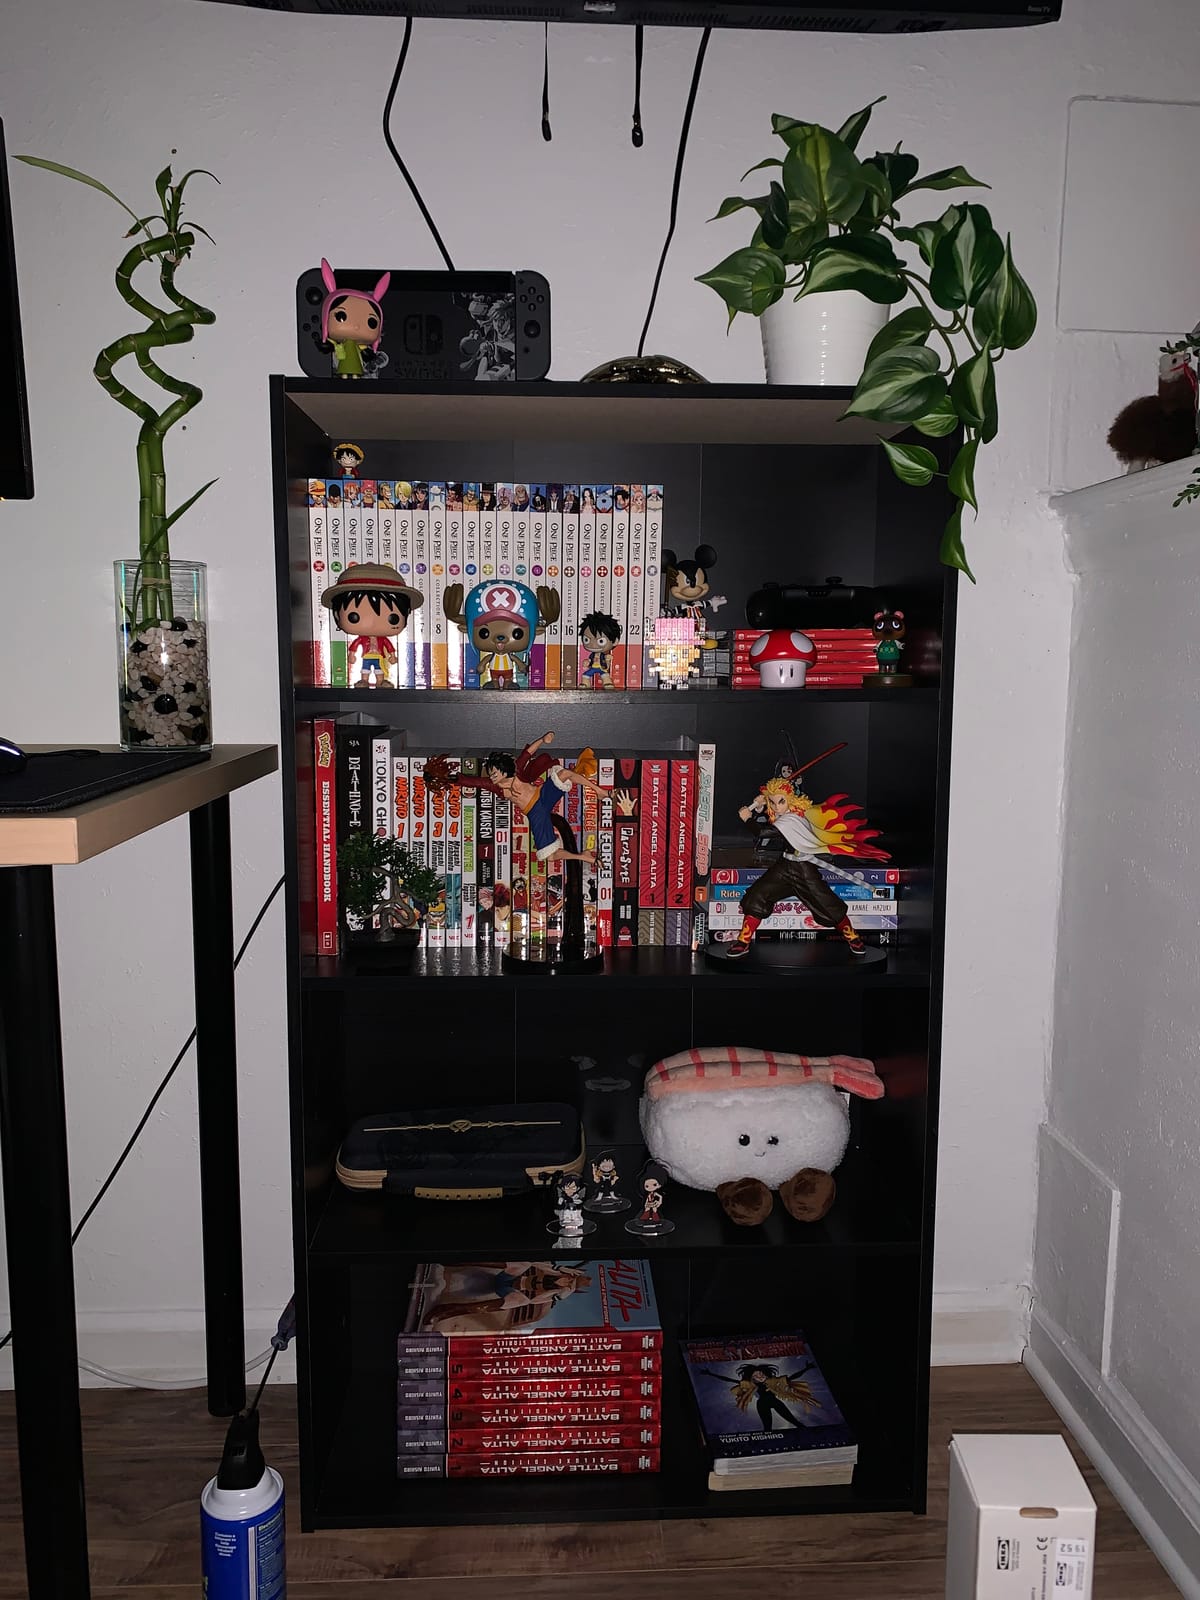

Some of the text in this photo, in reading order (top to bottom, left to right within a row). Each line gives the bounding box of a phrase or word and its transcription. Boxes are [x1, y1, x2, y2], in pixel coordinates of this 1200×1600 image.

[313, 518, 323, 556] ONE PIECE
[331, 518, 341, 557] ONE PIECE
[348, 518, 358, 557] ONE PIECE
[364, 518, 374, 557] ONE PIECE
[382, 520, 392, 558] ONE PIECE
[434, 520, 442, 538] ONE
[567, 524, 575, 541] ONE
[617, 522, 626, 540] ONE
[634, 522, 642, 540] ONE
[650, 522, 658, 540] ONE
[399, 520, 409, 559] ONE PIECE
[415, 520, 425, 559] ONE PIECE
[450, 522, 459, 560] ONE PIECE
[466, 520, 476, 560] ONE PIECE
[482, 520, 492, 560] ONE PIECE
[500, 522, 510, 560] ONE PIECE
[516, 522, 526, 560] ONE PIECE
[533, 522, 543, 561] ONE PIECE
[549, 522, 559, 561] ONE PIECE
[582, 524, 592, 562] ONE PIECE
[599, 522, 609, 562] ONE PIECE
[432, 540, 442, 560] PIECE
[566, 542, 574, 562] PIECE
[616, 541, 625, 561] PIECE
[633, 542, 642, 562] PIECE
[649, 541, 658, 561] PIECE
[435, 624, 442, 635] 8
[548, 624, 558, 636] 15
[564, 625, 574, 636] 16
[628, 624, 640, 636] 22
[375, 758, 387, 838] TOKYO GHO
[395, 776, 408, 818] NARUTO
[412, 776, 425, 818] NARUTO
[432, 791, 444, 819] RUTO
[448, 784, 460, 818] ARUTO
[496, 796, 508, 814] UNCH
[700, 773, 712, 821] SWEAT
[322, 781, 330, 842] ESSENTIAL
[584, 802, 597, 832] PIECE
[397, 823, 405, 839] 1
[414, 822, 423, 838] 2
[432, 822, 443, 838] 3
[448, 822, 458, 838] 4
[480, 810, 493, 839] KAISEN
[496, 831, 508, 843] 01
[586, 834, 596, 850] 6
[600, 797, 612, 879] FIRE FORCE
[678, 820, 686, 856] ANGEL
[484, 846, 490, 858] 1
[696, 832, 709, 876] SOAP
[600, 888, 611, 900] 01
[675, 894, 683, 904] 2
[720, 890, 741, 898] Ride
[572, 1343, 622, 1351] BATTLE
[451, 1364, 463, 1374] 5
[482, 1364, 620, 1375] BATTLE ANGEL ALITA
[452, 1388, 463, 1398] 4
[482, 1392, 519, 1400] ALITA
[571, 1389, 620, 1397] BATTLE
[452, 1438, 463, 1448] 2
[482, 1438, 620, 1448] BATTLE ANGEL ALITA
[720, 1436, 750, 1444] YUKITO
[751, 1433, 784, 1442] KISHIRO
[521, 1465, 565, 1473] ANGEL
[569, 1464, 618, 1472] BATTLE
